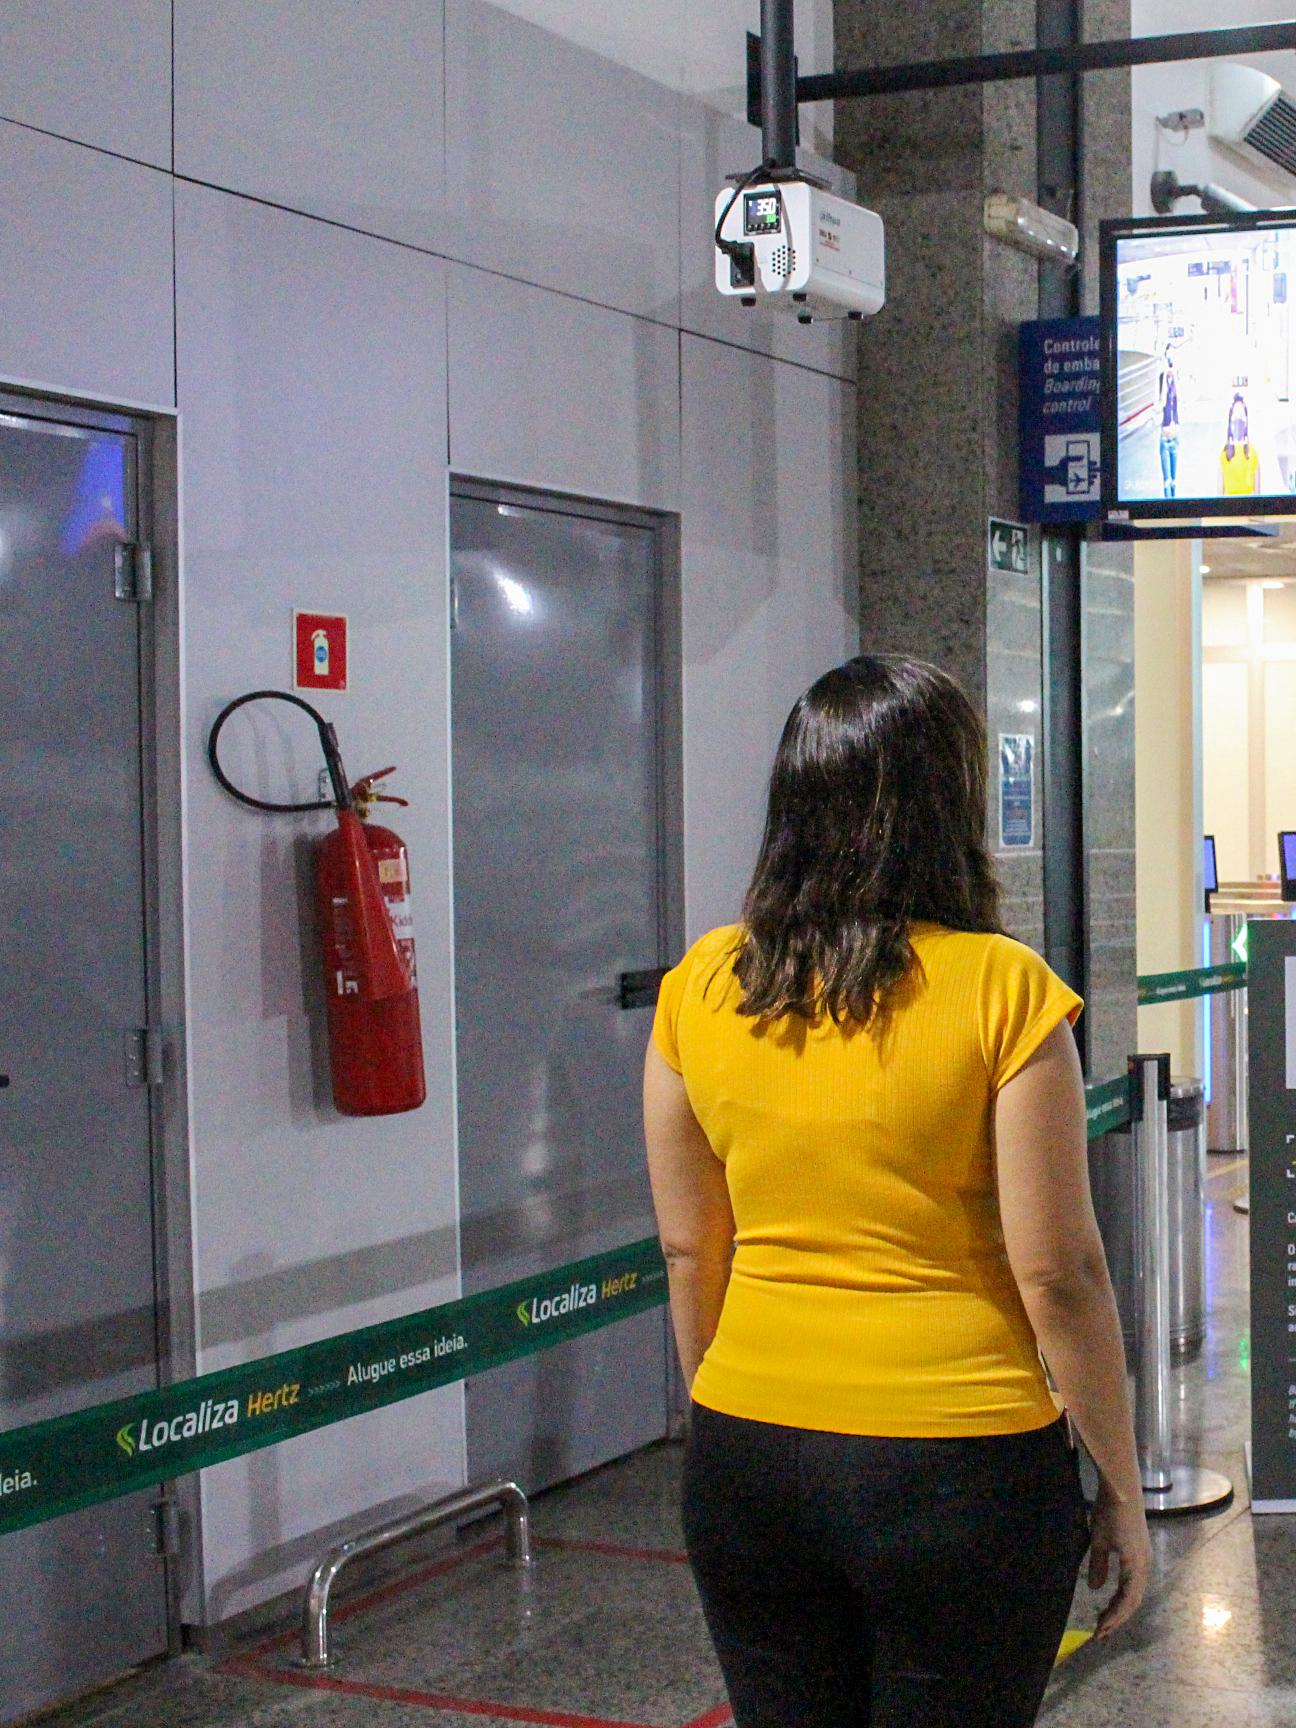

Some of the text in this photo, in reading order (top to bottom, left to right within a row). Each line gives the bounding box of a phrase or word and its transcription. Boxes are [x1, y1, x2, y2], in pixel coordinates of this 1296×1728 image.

[1044, 357, 1059, 373] de
[1043, 396, 1091, 413] control
[1287, 1244, 1295, 1255] O
[0, 1272, 637, 1497] eia. Localiza Hertz Alugue essa ideia. Localiza Hertz
